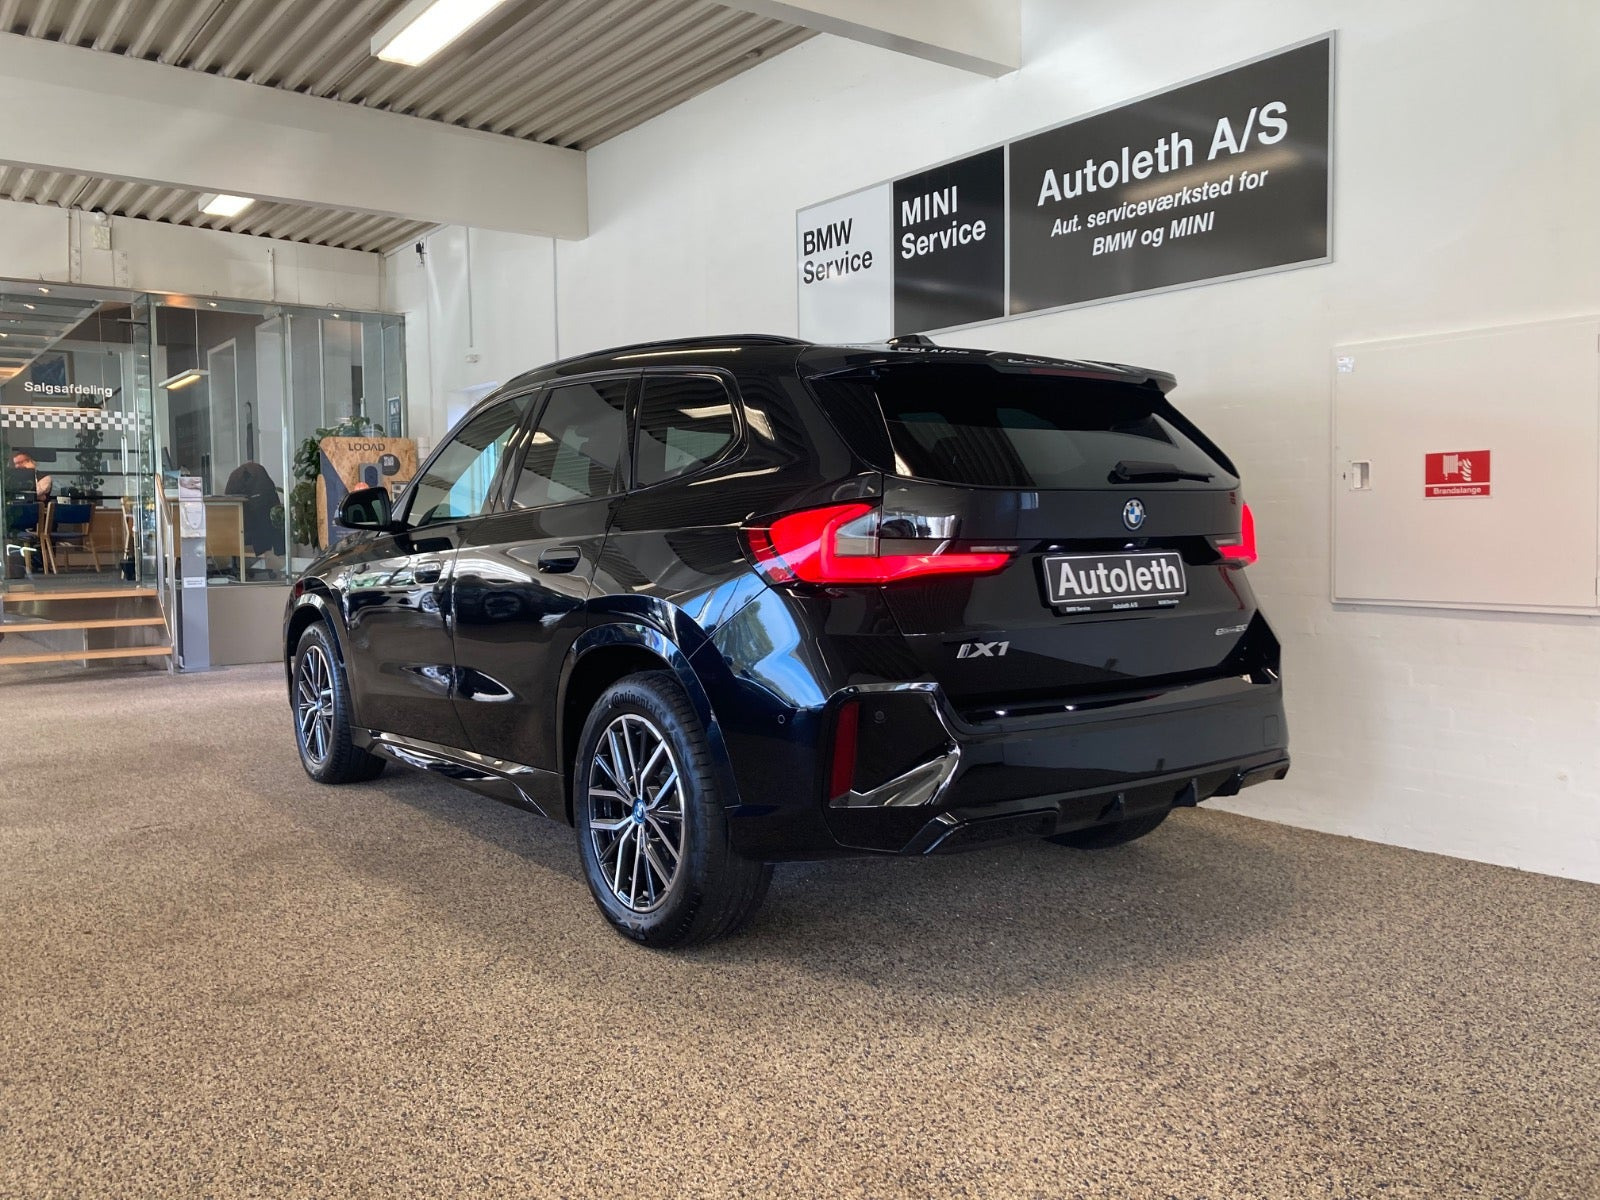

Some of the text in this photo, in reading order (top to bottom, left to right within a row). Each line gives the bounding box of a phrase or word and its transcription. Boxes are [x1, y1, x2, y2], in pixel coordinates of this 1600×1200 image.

[1037, 101, 1288, 207] Autoleth A/S
[902, 185, 957, 227] MINI
[1051, 170, 1269, 237] Aut. serviceværksted for
[803, 217, 852, 257] BMW
[901, 219, 986, 260] Service
[1092, 211, 1215, 256] BMW og MINI
[803, 250, 872, 284] Service
[24, 381, 113, 398] Salgsafdeling
[1433, 486, 1482, 495] Brandslange
[1058, 558, 1180, 596] Autoleth
[956, 641, 1010, 659] iX1
